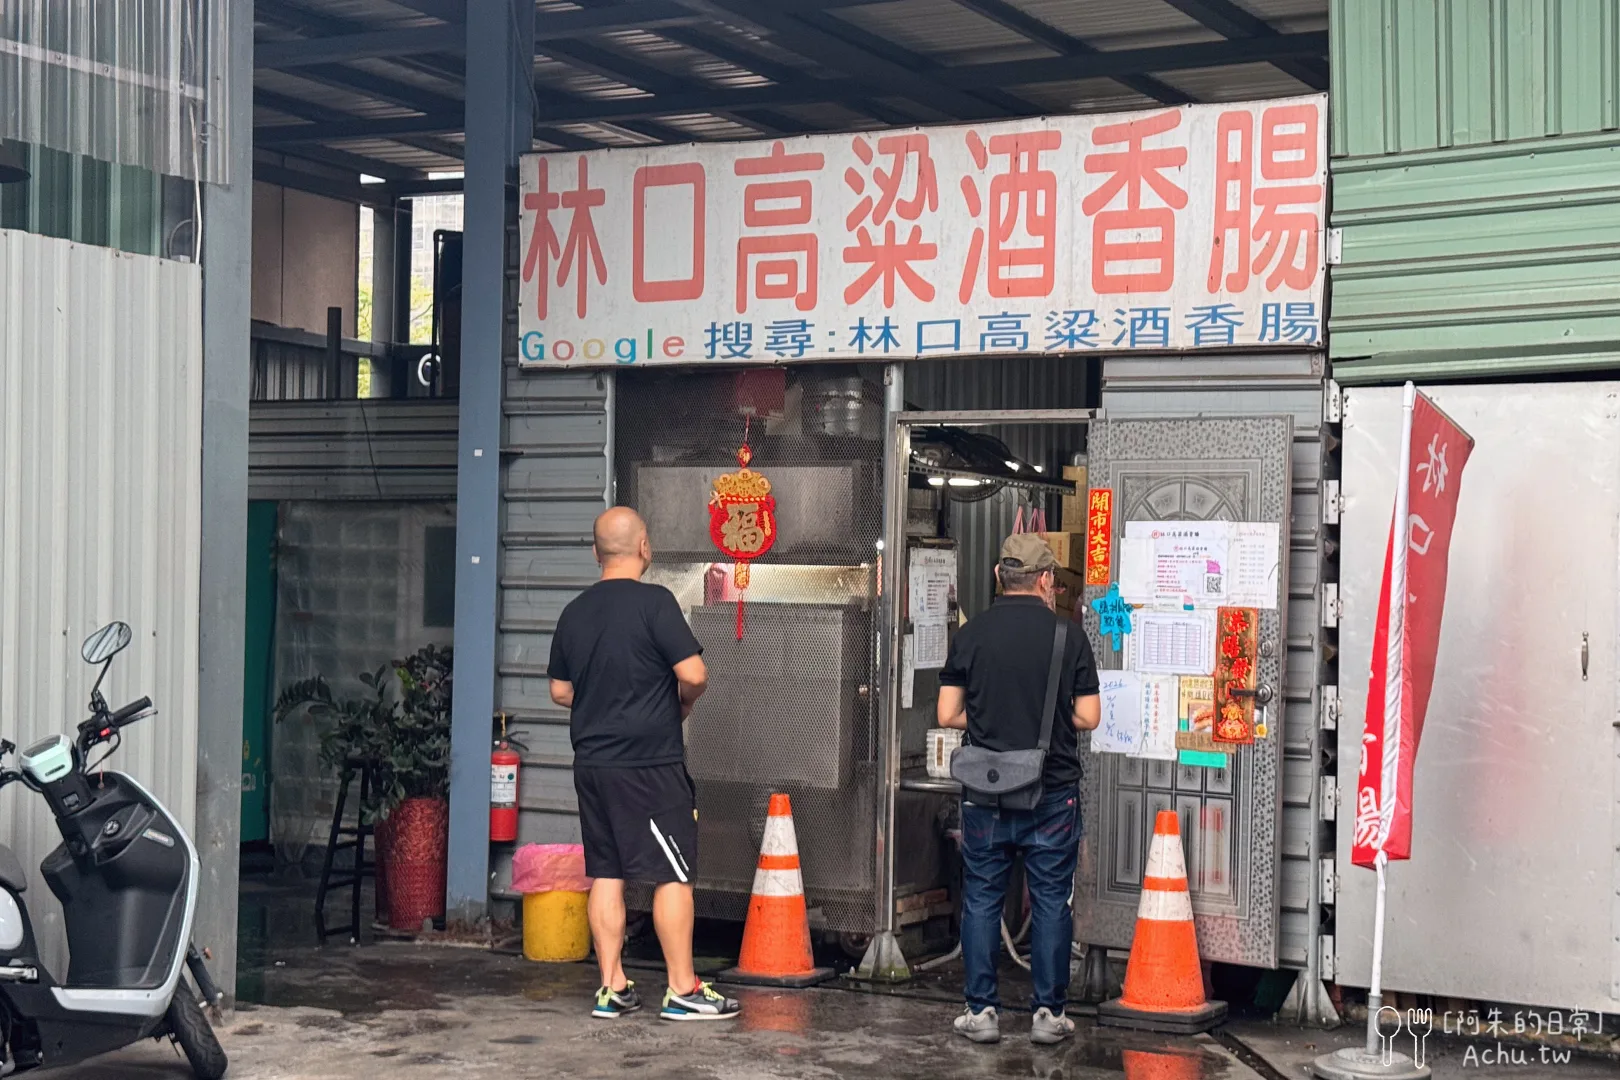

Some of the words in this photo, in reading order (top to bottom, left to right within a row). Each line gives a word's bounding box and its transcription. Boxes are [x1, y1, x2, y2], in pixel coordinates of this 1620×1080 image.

[521, 104, 1326, 323] 林口高粱酒香腸
[520, 327, 686, 364] Google
[720, 502, 765, 552] 福
[1089, 490, 1110, 563] 開市大吉
